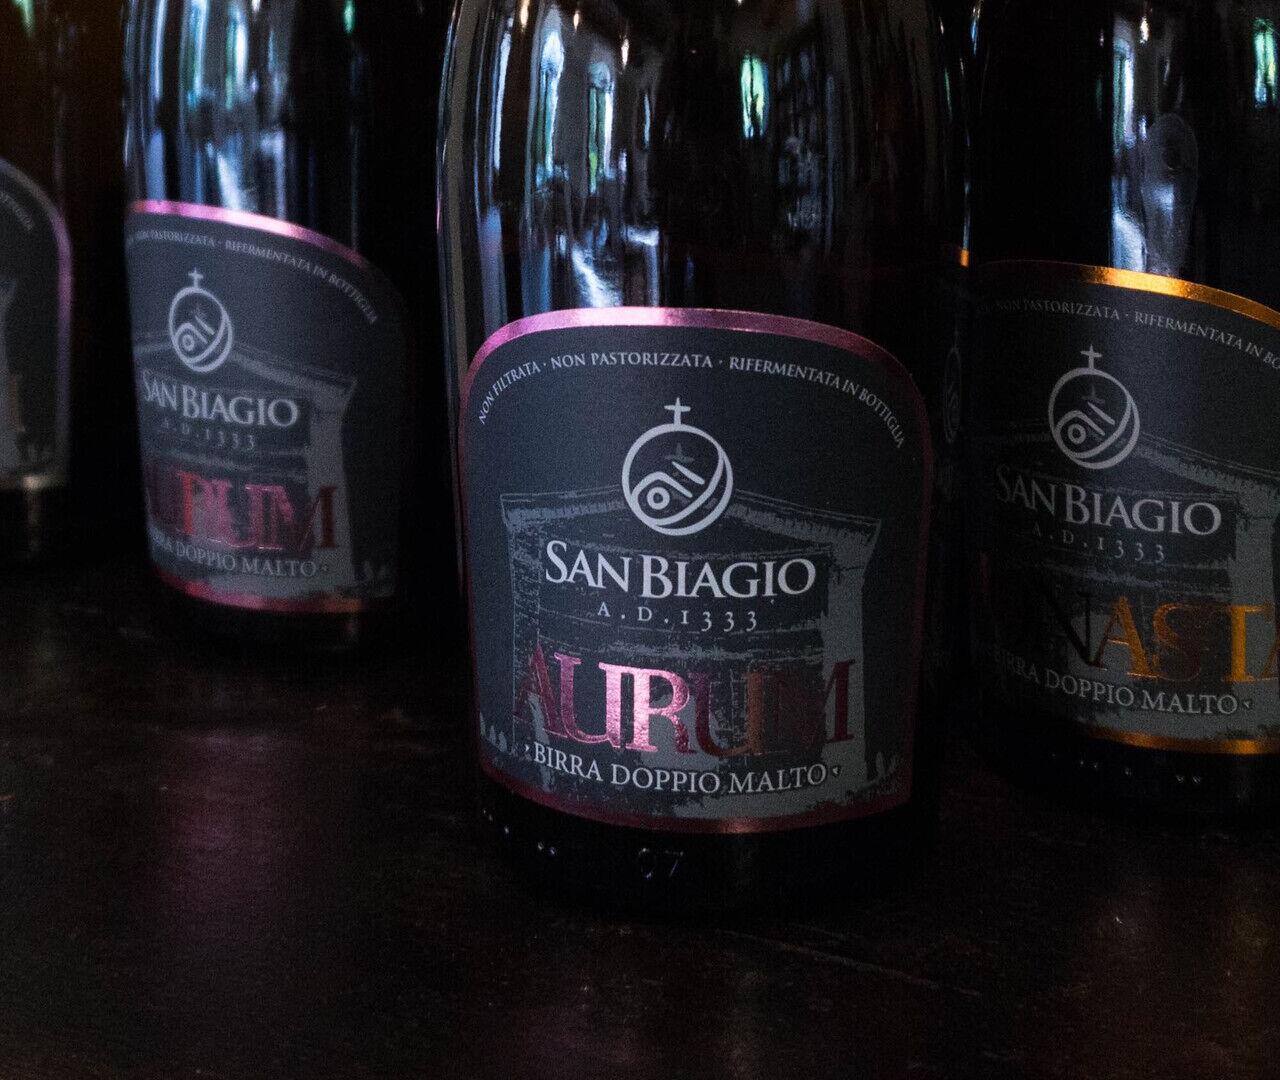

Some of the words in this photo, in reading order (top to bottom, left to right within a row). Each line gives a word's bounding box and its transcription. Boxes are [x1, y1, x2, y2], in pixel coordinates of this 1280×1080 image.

[1023, 298, 1121, 321] PASTORIZZATA
[1135, 311, 1244, 351] RIFERMENTATA
[1244, 341, 1265, 358] IN
[141, 368, 177, 411] SAN
[181, 384, 300, 428] BIAGIO
[478, 391, 495, 425] NON
[491, 360, 543, 399] FILTRATA
[550, 352, 587, 370] NON
[591, 351, 714, 369] PASTORIZZATA
[728, 355, 842, 390] RIFERMENTATA
[842, 378, 860, 397] IN
[858, 386, 906, 449] BOTTIGLIA
[995, 462, 1057, 517] SAN
[1064, 482, 1223, 537] BIAGIO
[175, 541, 237, 571] DOPPIO
[241, 556, 318, 577] MALTO
[545, 539, 632, 594] SAN
[639, 553, 817, 601] BIAGIO
[512, 644, 857, 758] AURUM
[1045, 668, 1135, 708] DOPPIO
[1140, 690, 1239, 715] MALTO
[533, 741, 605, 783] BIRRA
[610, 764, 722, 795] DOPPIO
[727, 763, 827, 796] MALTO
